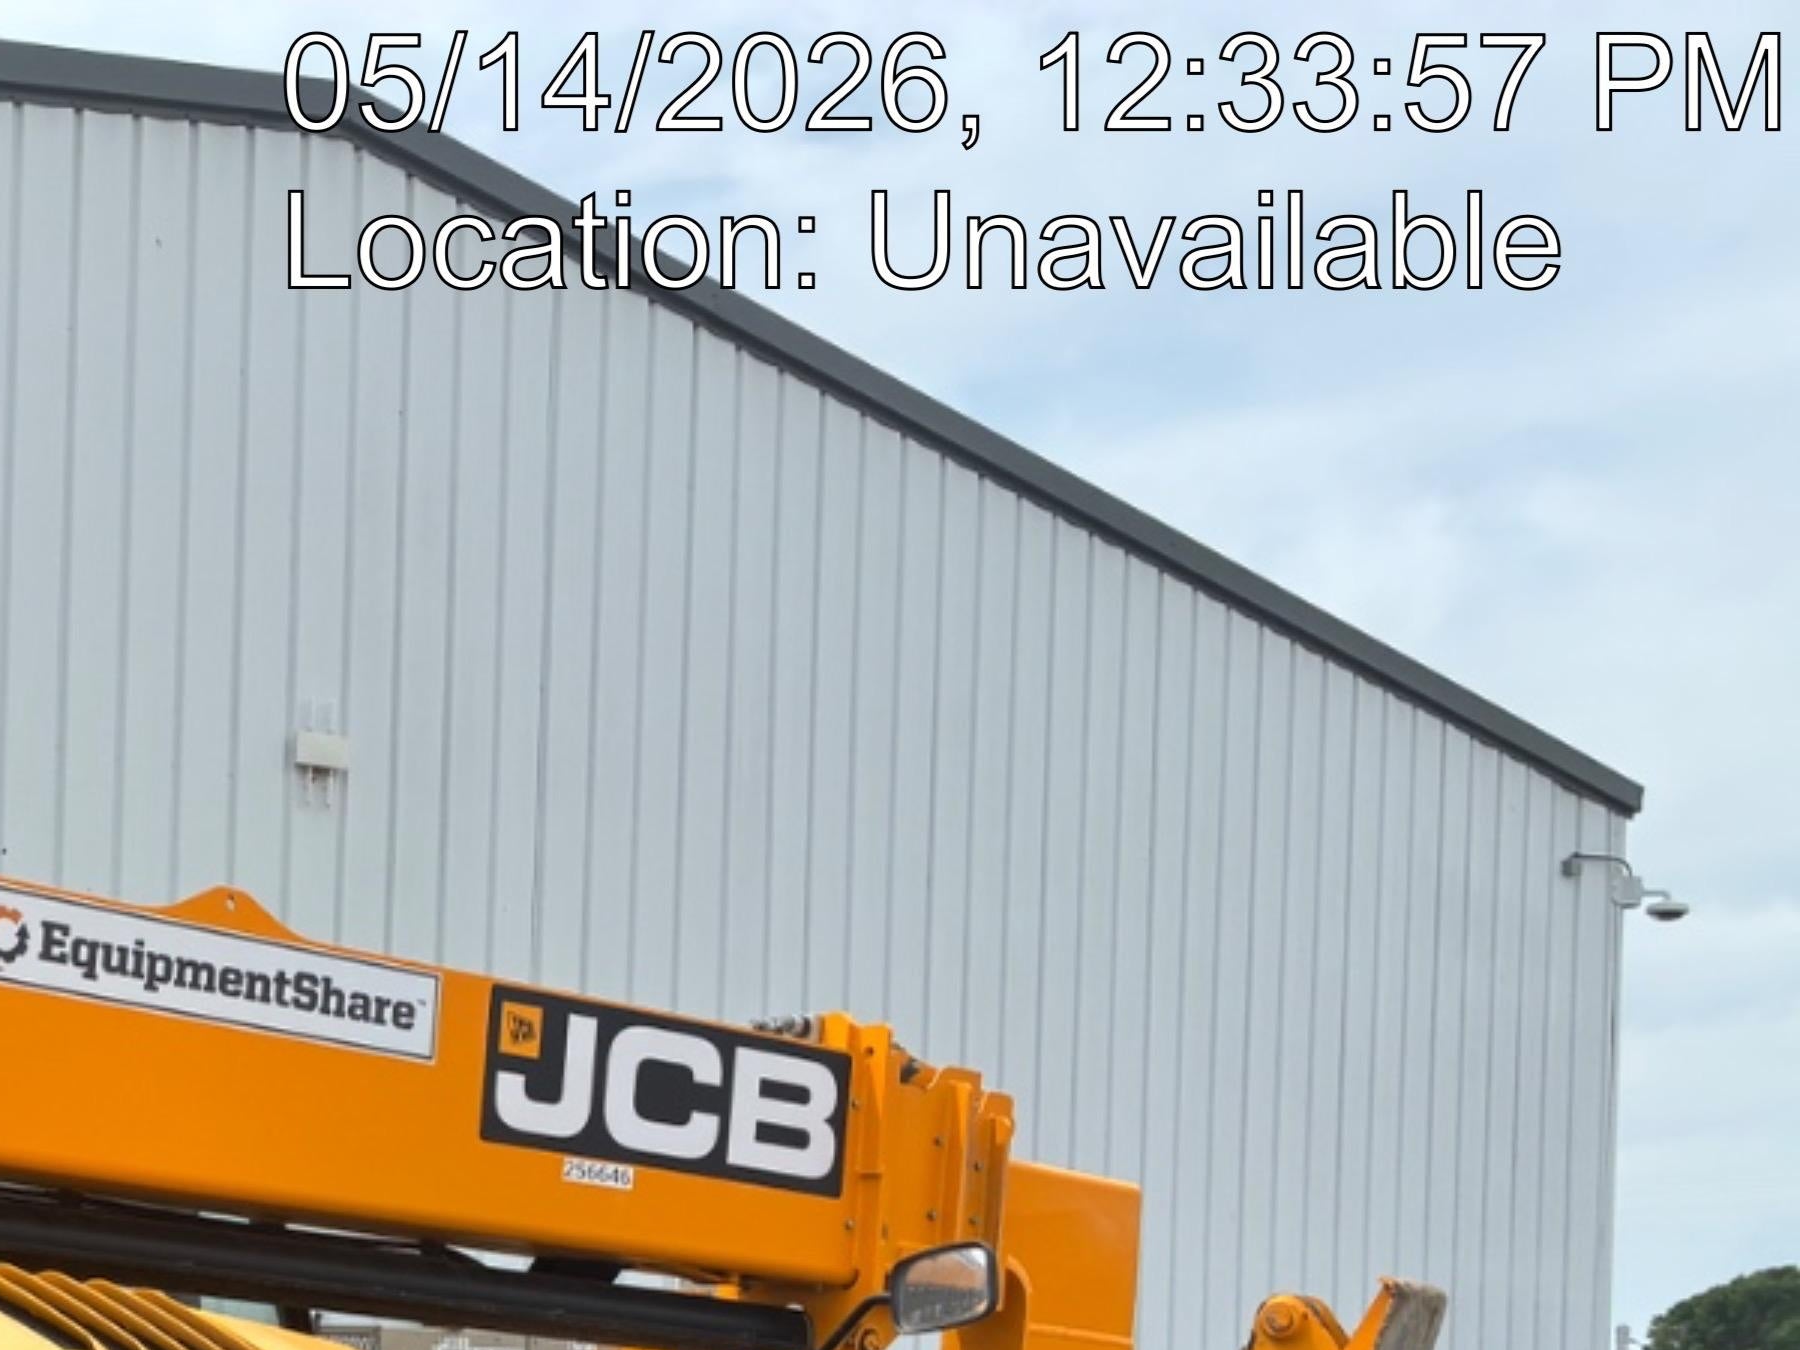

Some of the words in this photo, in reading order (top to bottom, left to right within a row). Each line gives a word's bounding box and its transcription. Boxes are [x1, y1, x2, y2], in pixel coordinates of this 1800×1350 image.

[38, 919, 415, 1031] EquipmentShare
[494, 1012, 838, 1181] JCB
[564, 1160, 631, 1185] 256646
